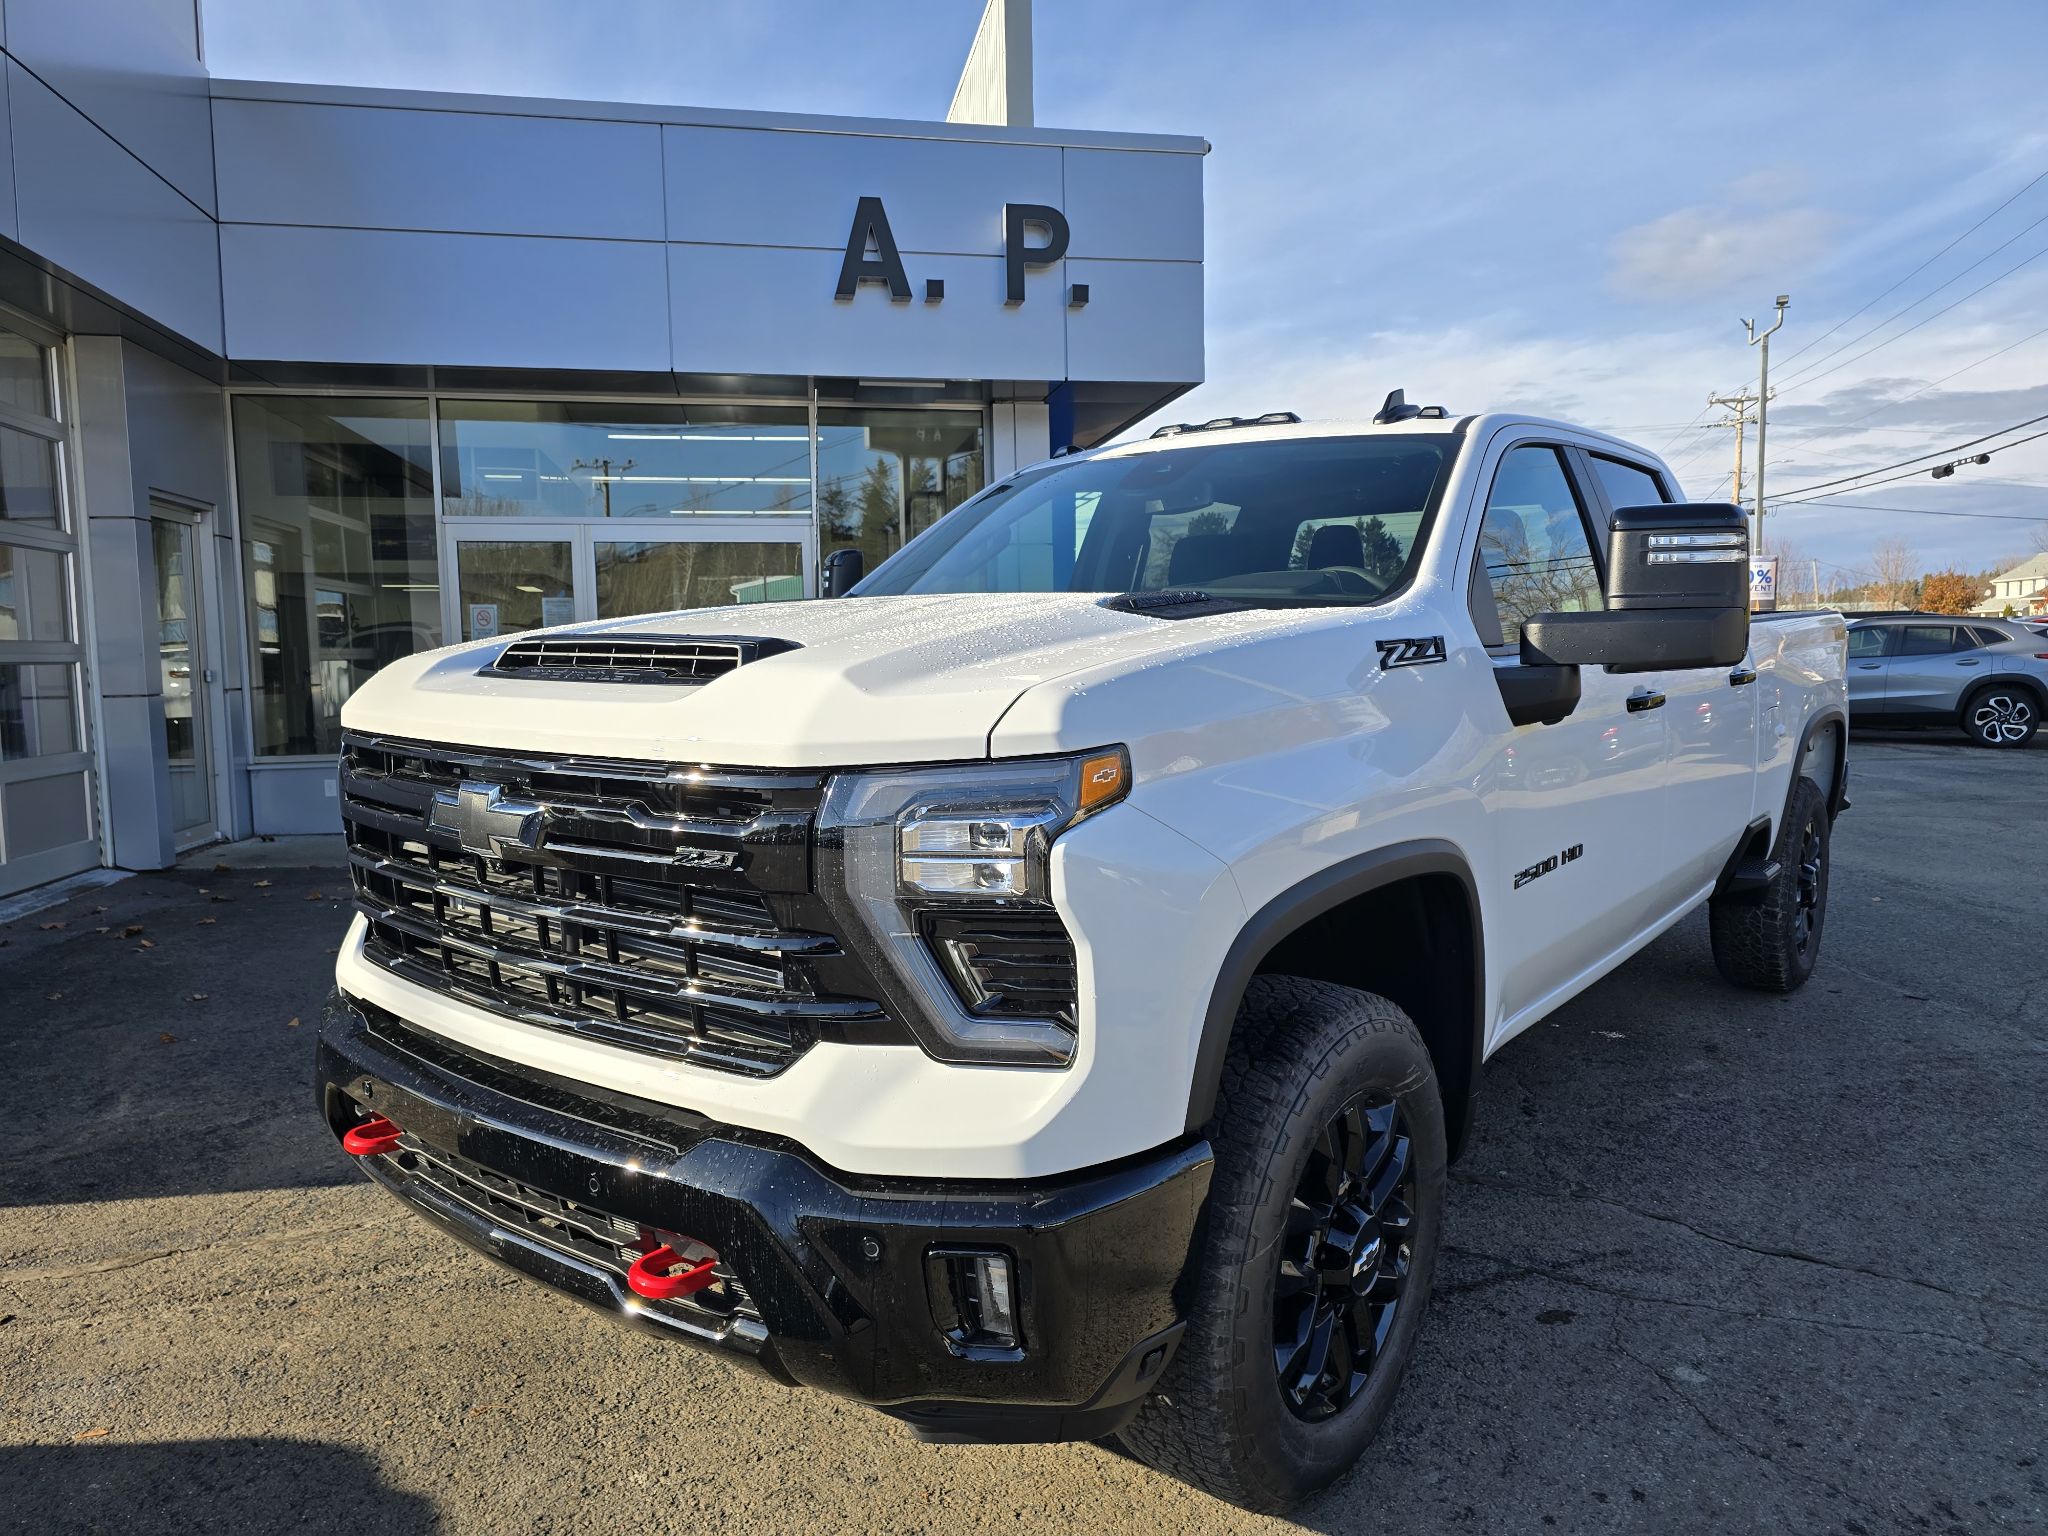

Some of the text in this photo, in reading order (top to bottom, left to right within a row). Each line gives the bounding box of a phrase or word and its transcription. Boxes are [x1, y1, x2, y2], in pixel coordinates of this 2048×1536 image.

[834, 196, 1089, 308] A. P.
[1375, 635, 1447, 671] Z71
[1513, 842, 1584, 890] 2500 HD
